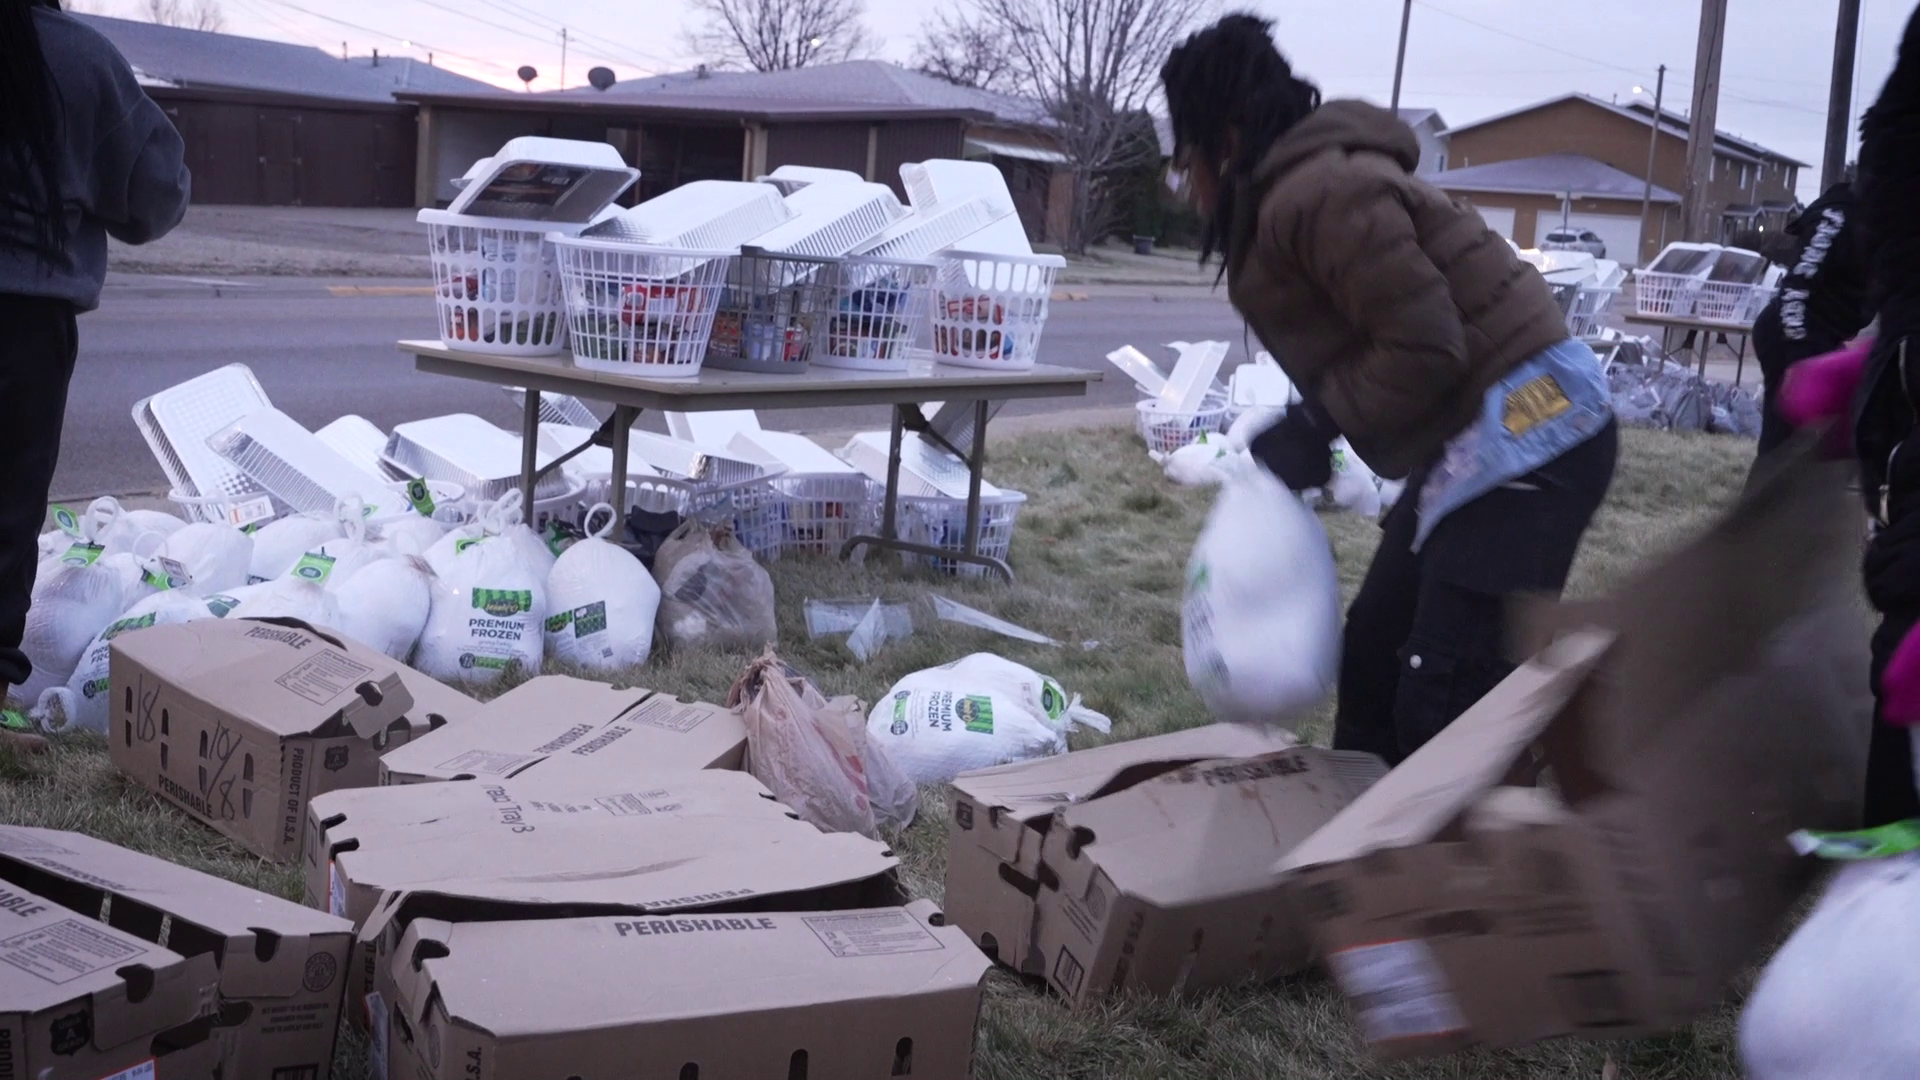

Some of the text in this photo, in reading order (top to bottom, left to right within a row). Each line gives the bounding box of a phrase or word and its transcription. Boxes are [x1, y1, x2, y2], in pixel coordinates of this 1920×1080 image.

[243, 624, 312, 650] PERISHABLE
[468, 618, 525, 631] PREMIUM
[471, 628, 522, 641] FROZEN
[928, 691, 940, 728] FROZEN
[941, 691, 953, 732] PREMIUM
[532, 723, 594, 756] PERISHABLE
[572, 725, 632, 756] PERISHABLE
[158, 773, 213, 818] PERISHABLE
[283, 747, 304, 845] PRODUCT OF U.S.A.
[614, 917, 777, 937] PERISHABLE
